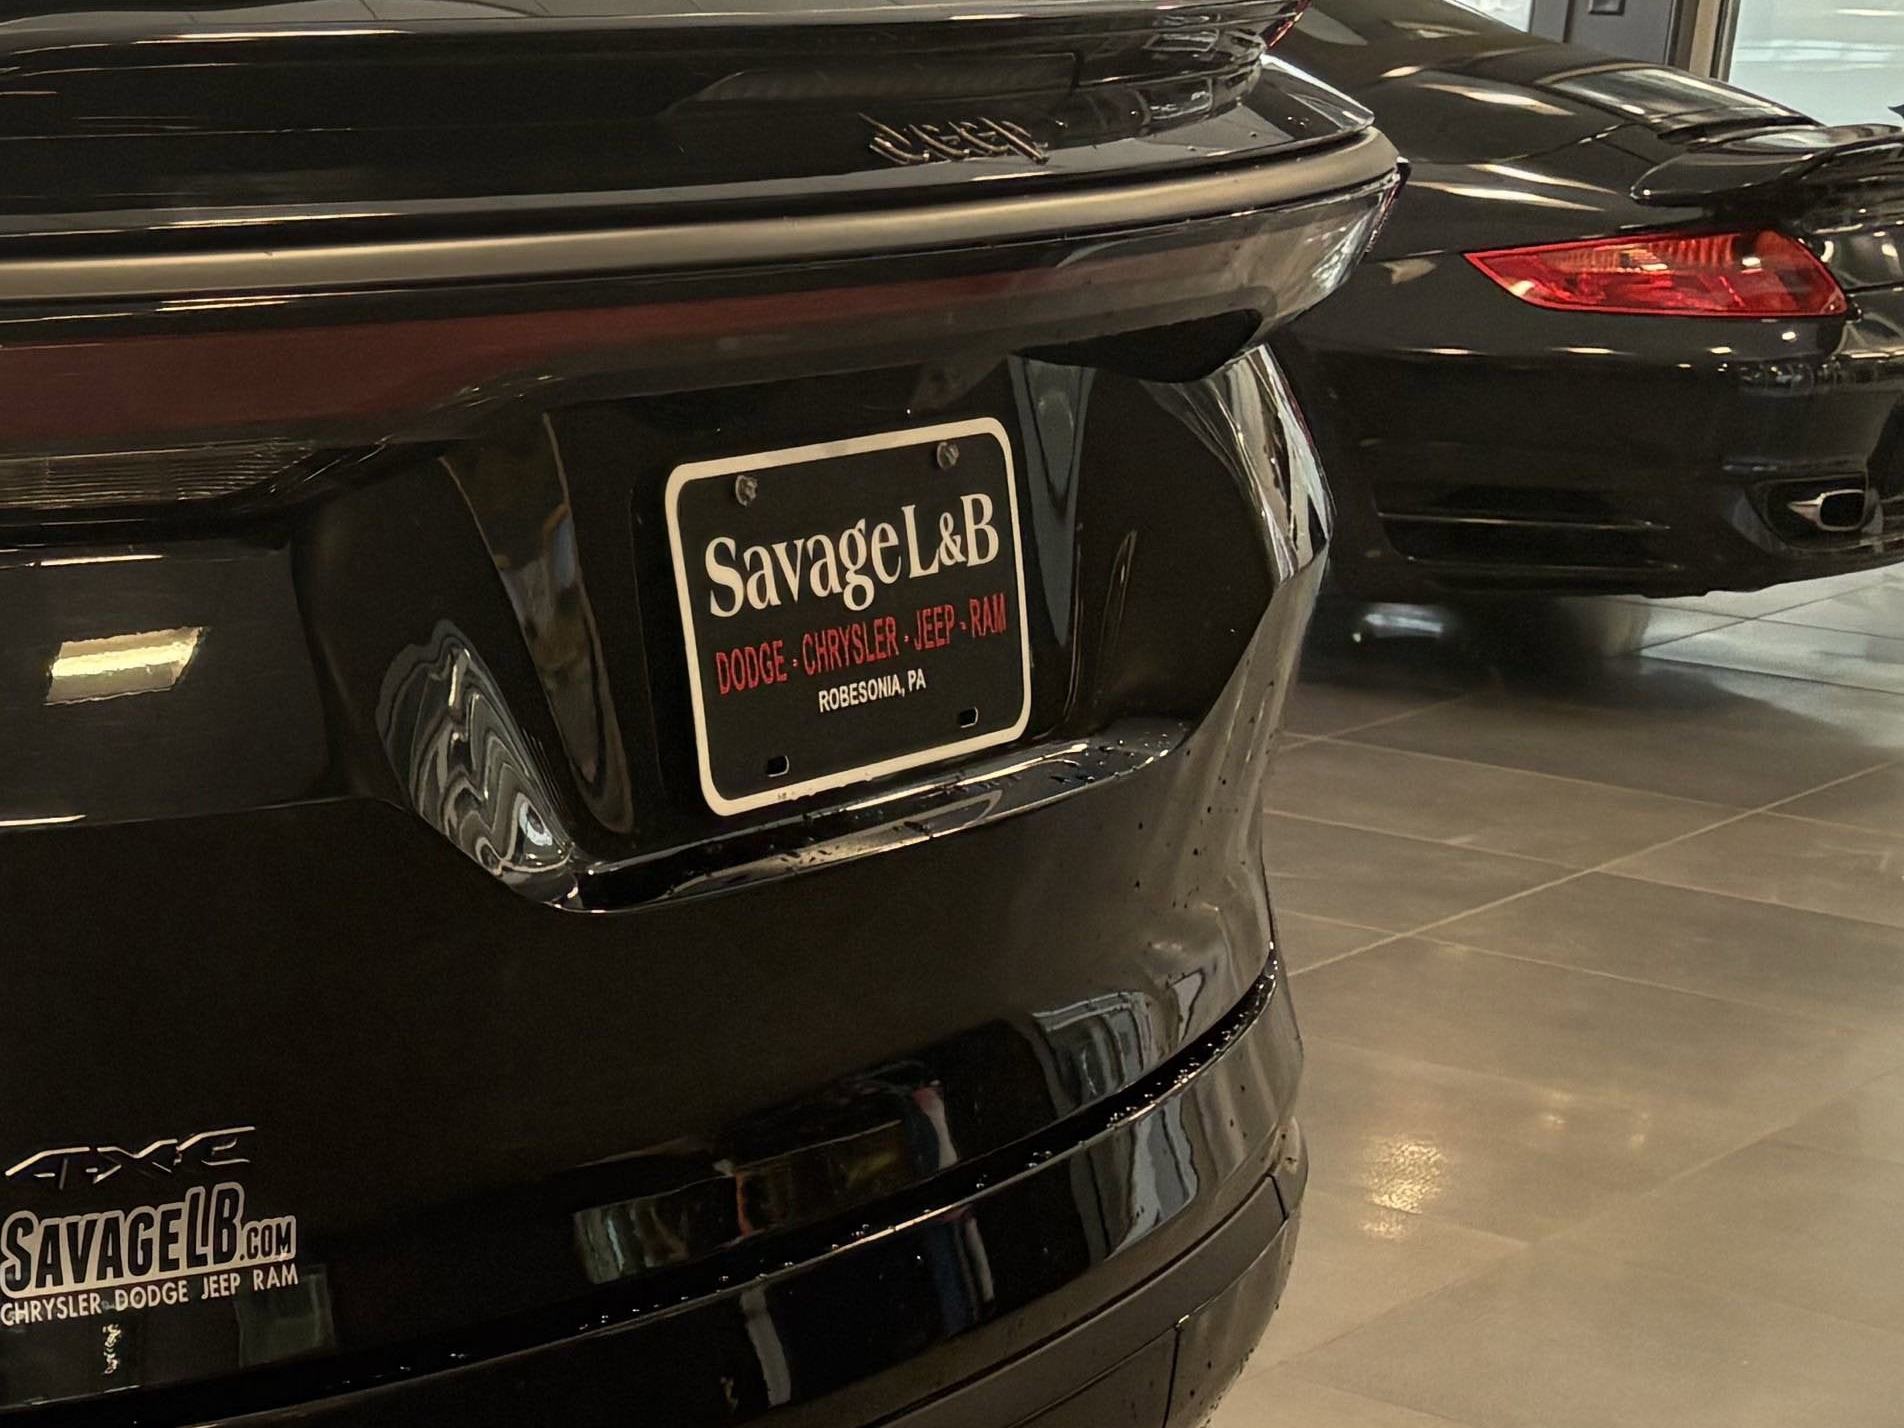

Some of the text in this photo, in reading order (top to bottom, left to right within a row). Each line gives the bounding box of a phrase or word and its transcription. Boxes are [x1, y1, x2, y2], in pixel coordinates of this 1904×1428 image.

[715, 593, 1007, 695] DODGE CHRYSLER JEEP RAM
[818, 668, 927, 713] ROBESONIA, PA
[0, 1263, 299, 1326] CHRYSLER DODGE JEEP RAM
